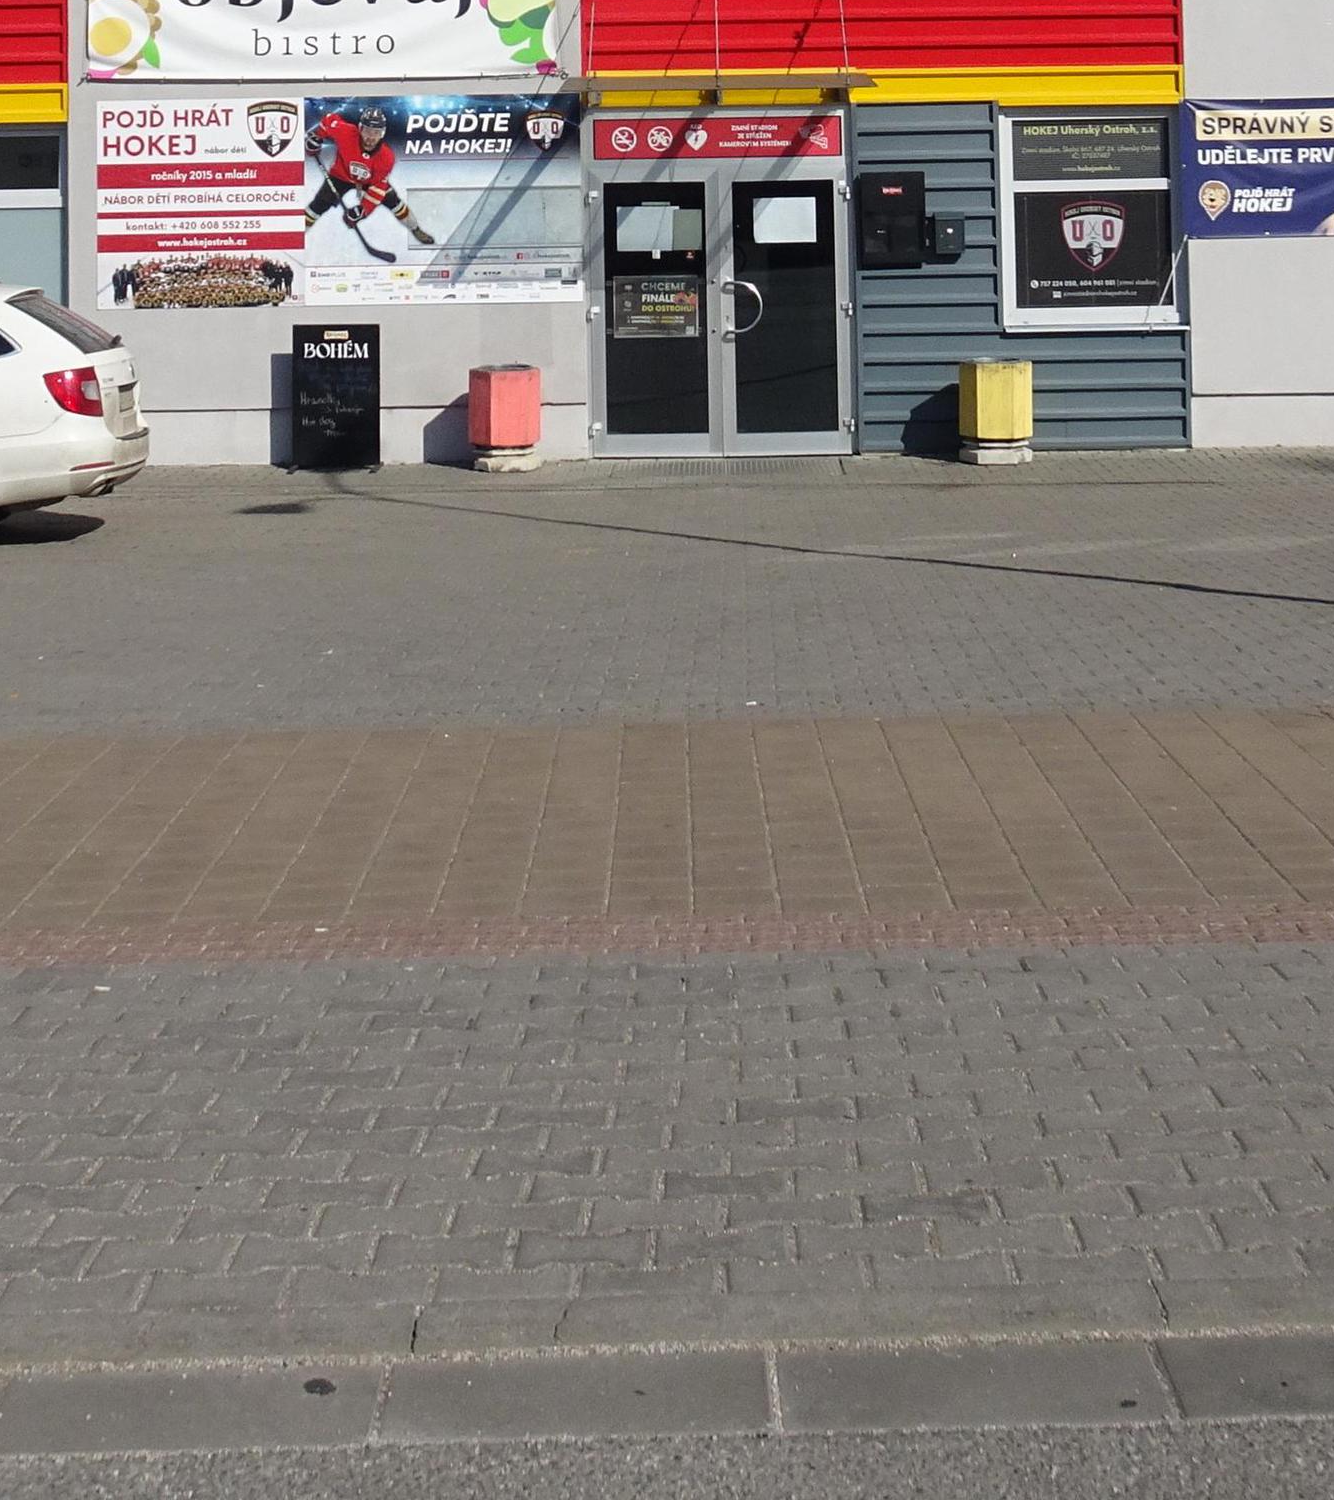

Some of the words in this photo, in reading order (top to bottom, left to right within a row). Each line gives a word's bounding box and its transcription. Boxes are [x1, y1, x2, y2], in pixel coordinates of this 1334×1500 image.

[252, 29, 395, 56] bistro
[103, 104, 164, 128] POJĎ
[173, 103, 233, 128] HRÁT
[406, 110, 511, 134] POJĎTE
[1202, 112, 1310, 135] SPRÁVNÝ
[1023, 126, 1058, 135] HOKEJ
[1061, 125, 1100, 136] Uherský
[103, 135, 196, 157] HOKEJ
[405, 139, 434, 155] NA
[440, 138, 512, 154] HOKEJ!
[1197, 146, 1292, 165] UDĚLEJTE
[151, 170, 187, 183] ročníky
[189, 170, 213, 180] 2015
[225, 169, 257, 180] mladší
[104, 193, 144, 205] NÁBOR
[148, 192, 171, 204] DĚTÍ
[174, 192, 223, 204] PROBÍHÁ
[1264, 187, 1295, 198] HRÁT
[1232, 198, 1293, 213] HOKEJ
[126, 222, 167, 232] kontakt:
[171, 221, 197, 231] +420
[200, 221, 219, 230] 608
[222, 220, 240, 229] 552
[243, 220, 261, 229] 255
[304, 340, 369, 358] BOHÉM
